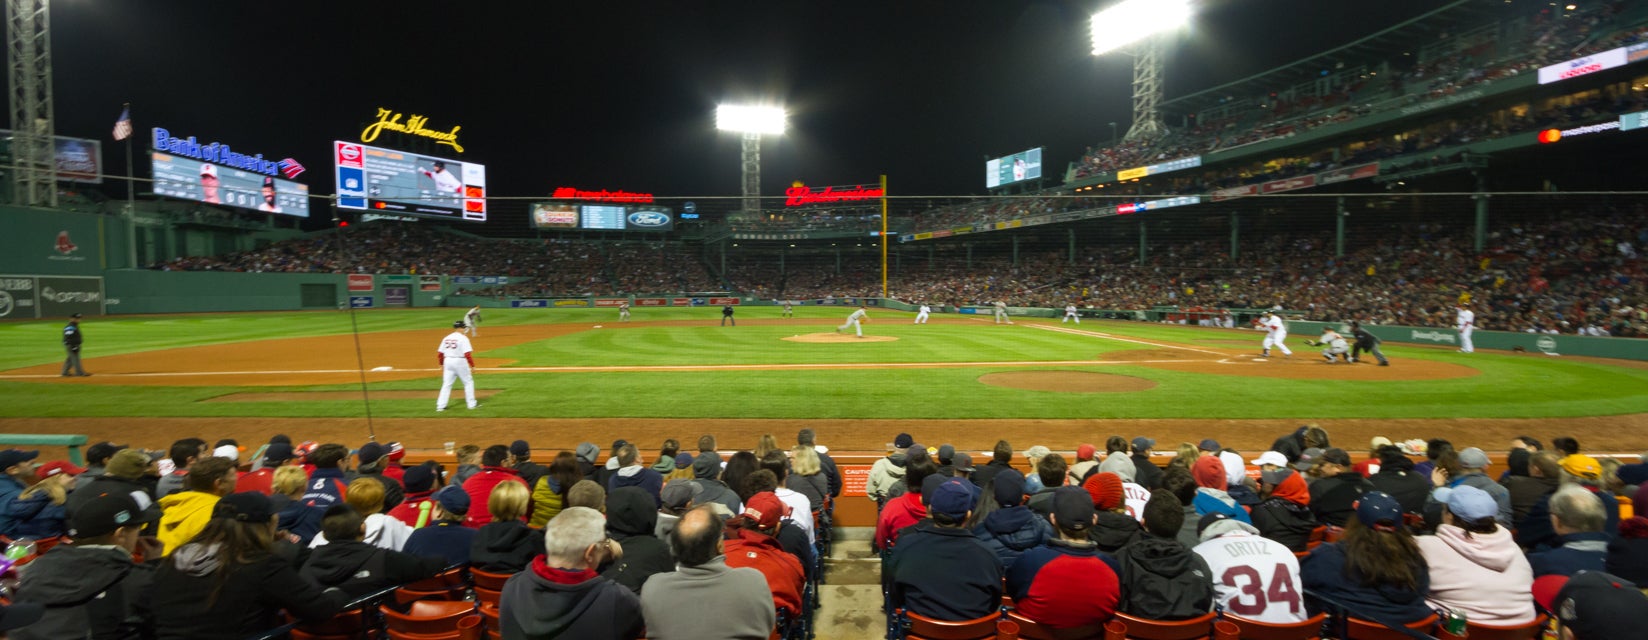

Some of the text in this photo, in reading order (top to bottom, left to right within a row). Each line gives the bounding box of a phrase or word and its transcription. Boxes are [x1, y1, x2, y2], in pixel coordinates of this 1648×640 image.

[361, 108, 464, 153] John Hancock
[152, 127, 279, 176] Bank of America
[785, 186, 884, 206] Budweiser
[633, 213, 663, 226] Ford
[56, 292, 101, 303] OPTUM
[1224, 540, 1273, 558] ORTIZ
[1221, 562, 1301, 616] 34
